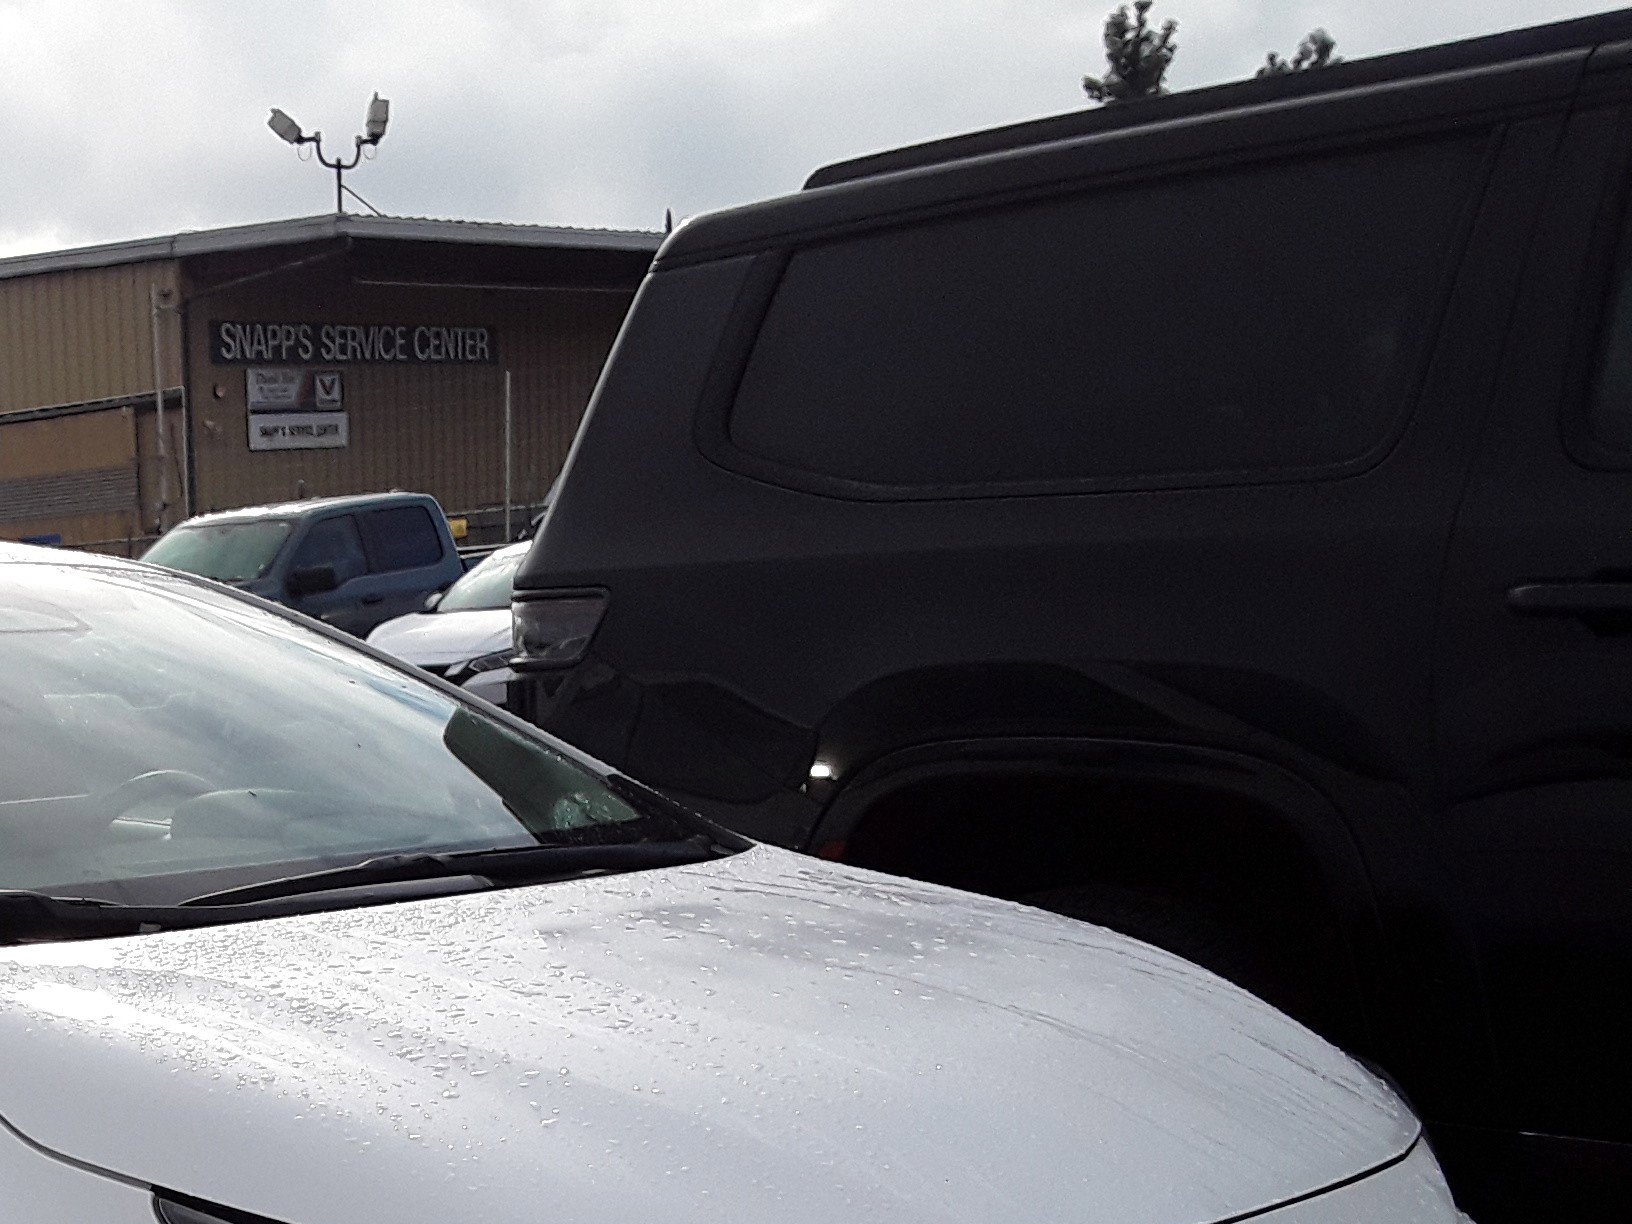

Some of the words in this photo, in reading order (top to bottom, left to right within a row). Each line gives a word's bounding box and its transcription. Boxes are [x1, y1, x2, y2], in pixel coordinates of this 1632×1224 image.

[219, 322, 313, 361] SNAPP'S
[320, 325, 408, 361] SERVICE
[414, 326, 490, 361] CENTER
